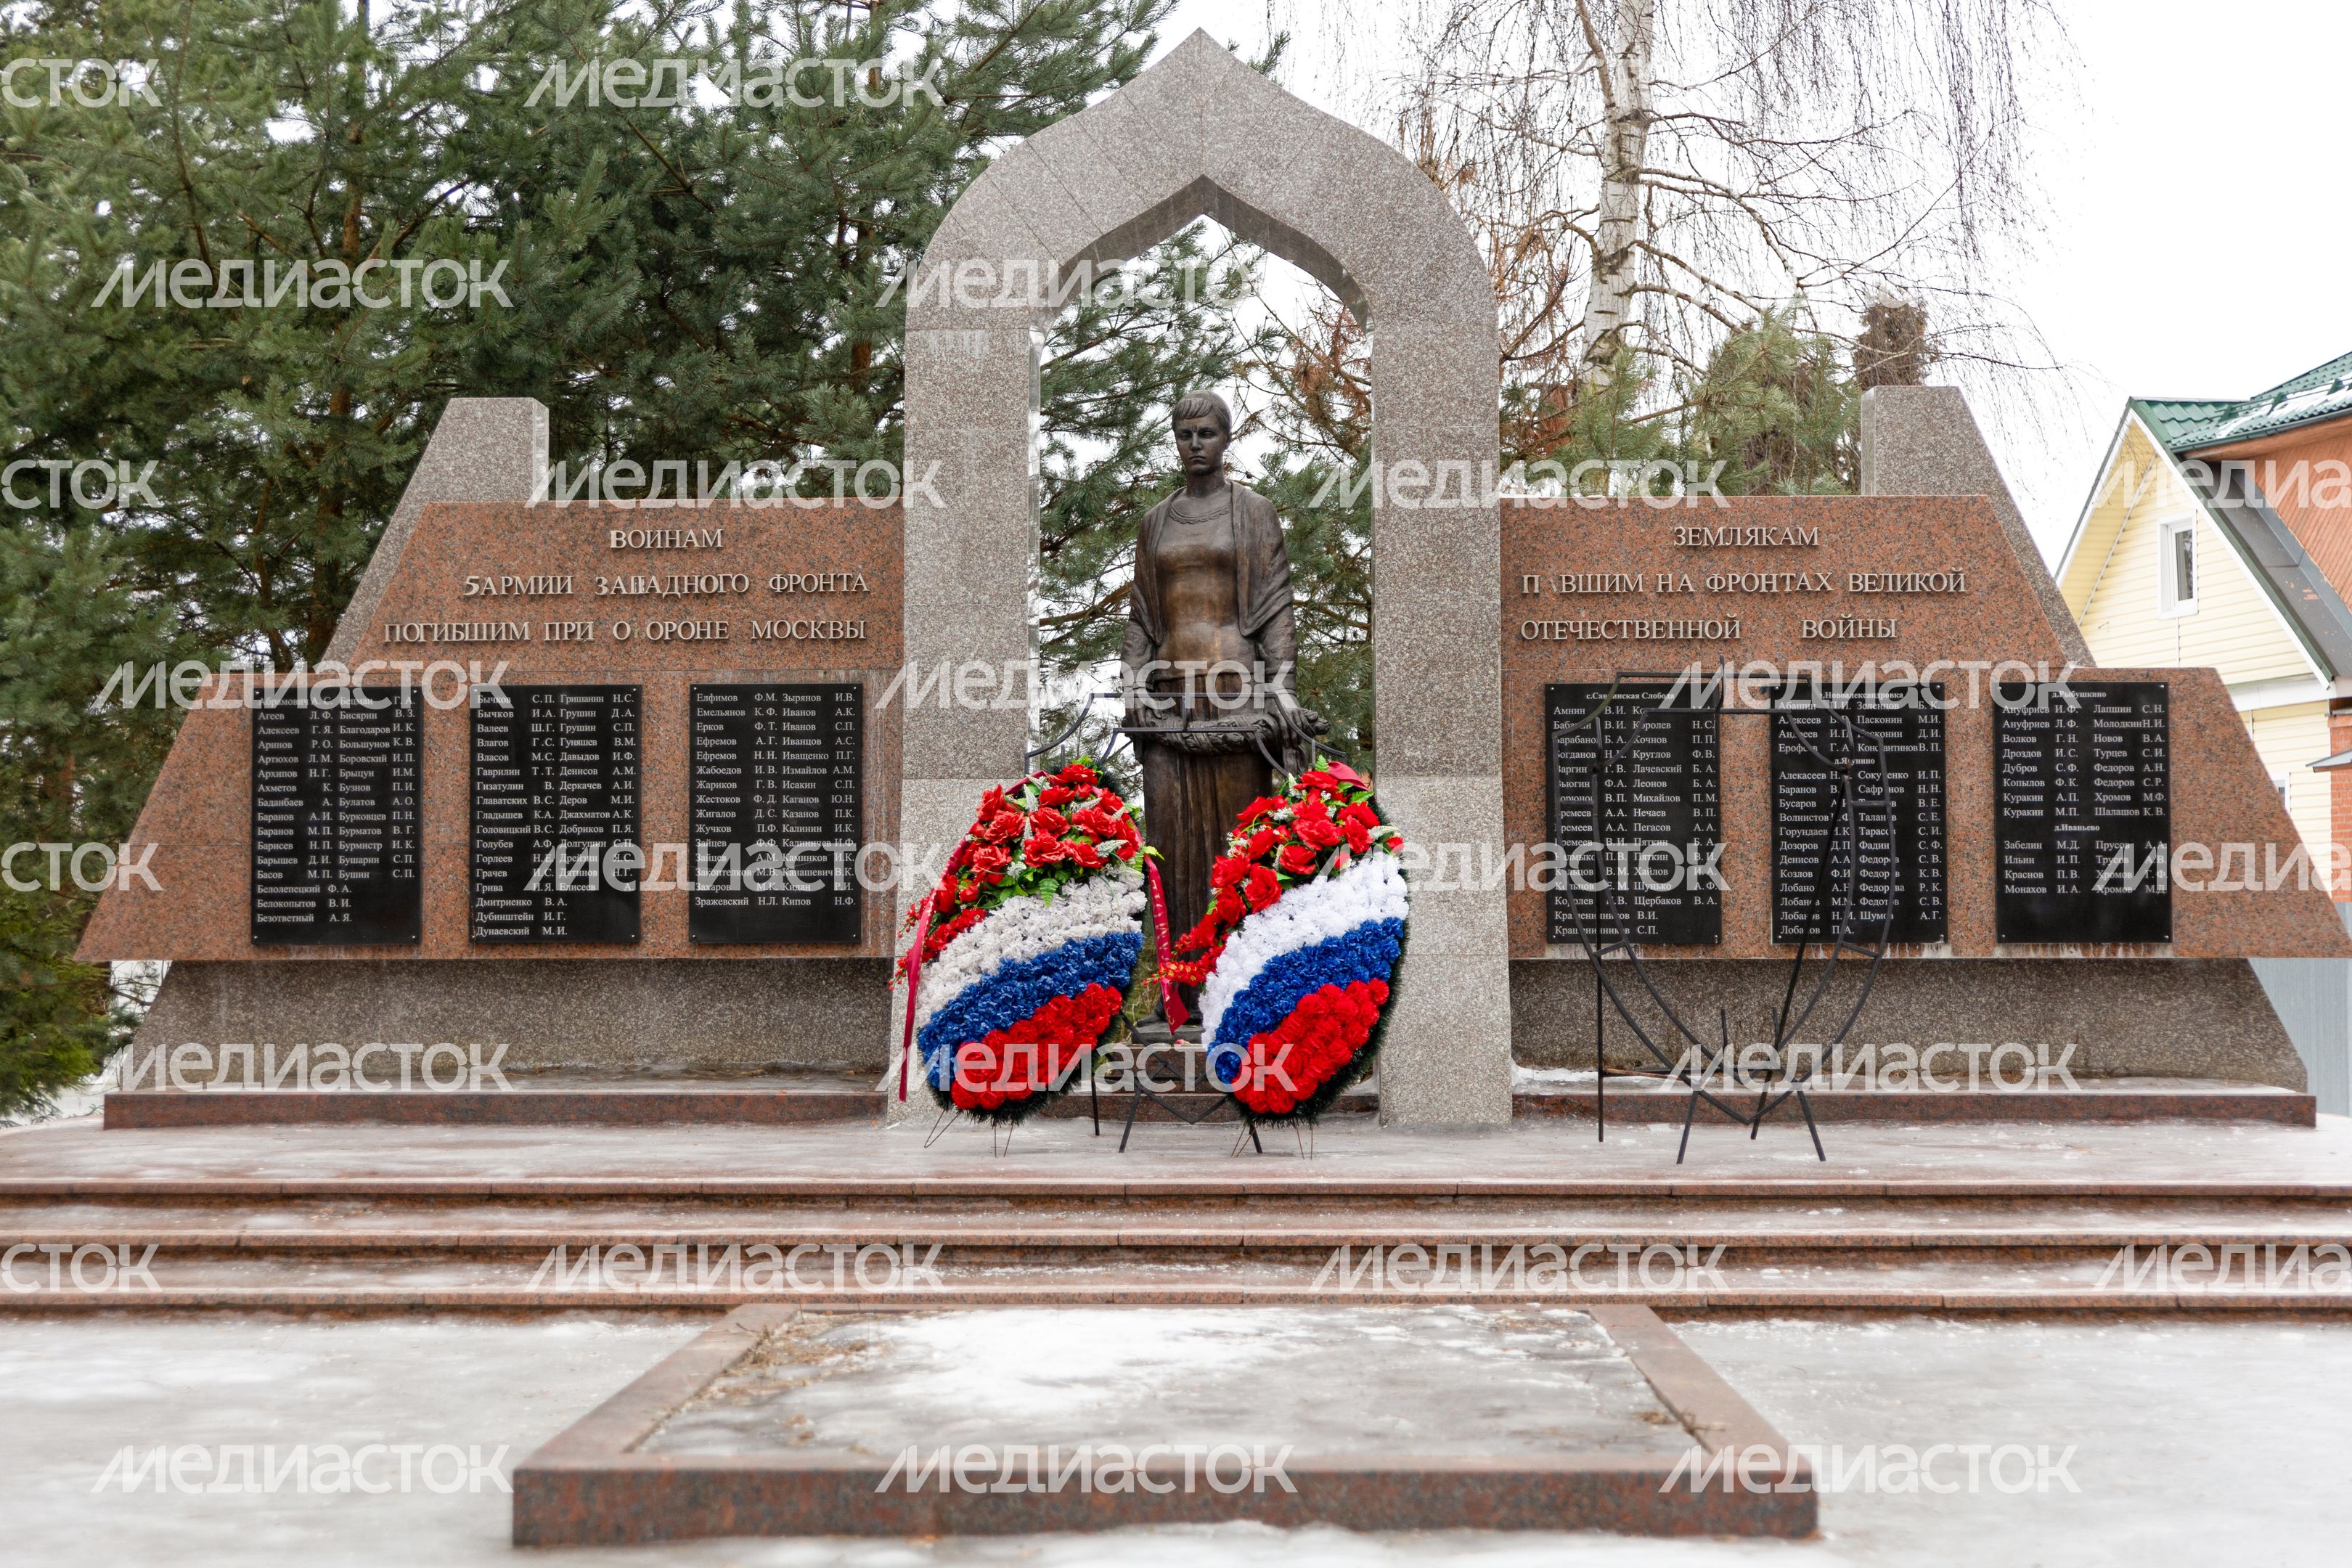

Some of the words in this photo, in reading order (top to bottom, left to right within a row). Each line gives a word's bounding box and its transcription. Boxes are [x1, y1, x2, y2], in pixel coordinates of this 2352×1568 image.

[610, 528, 724, 549] ВОИНАМ
[1673, 526, 1819, 546] ЗЕМЛЯКАМ
[1656, 573, 1696, 593] НА
[1706, 572, 1834, 593] ФРОНТАХ
[1848, 567, 1966, 593] ВЕЛИКОЙ
[595, 573, 749, 599] ЗАПАДНОГО
[768, 573, 870, 593] ФРОНТА
[383, 621, 531, 642] ПОГИБШИМ
[544, 621, 595, 642] ПРИ
[613, 621, 730, 640] ООРОНЕ
[751, 620, 867, 640] МОСКВЫ
[1521, 613, 1741, 640] ОТЕЧЕСТВЕННОЙ
[1800, 614, 1898, 639] ВОЙНЫ
[560, 694, 604, 705] Гришанин
[696, 693, 738, 704] Елфимов
[782, 693, 822, 704] Зырянов
[477, 709, 514, 718] Бычков
[560, 709, 596, 719] Грушин
[696, 707, 746, 716] Емельянов
[782, 708, 817, 716] Иванов
[1553, 706, 1585, 715] Амнин
[2093, 704, 2132, 714] Лапшин
[258, 711, 285, 720] Агеев
[340, 711, 377, 722] Бисярин
[1856, 715, 1903, 724] Пасконин
[477, 724, 509, 732] Валеев
[696, 722, 724, 733] Ерков
[2002, 719, 2051, 731] Ануфриев
[2093, 719, 2142, 729] Молодкин
[258, 726, 300, 735] Алексеев
[339, 725, 391, 736] Благодаров
[560, 737, 598, 748] Гуняшев
[696, 736, 738, 748] Ефремов
[783, 736, 822, 746] Иванцов
[2002, 734, 2037, 743] Волков
[2093, 733, 2123, 743] Новов
[339, 739, 391, 751] Большунов
[477, 752, 510, 761] Власов
[782, 751, 829, 761] Иващенко
[1633, 749, 1672, 761] Круглов
[2002, 748, 2042, 760] Дроздов
[2093, 748, 2128, 759] Турцев
[339, 754, 388, 765] Боровский
[339, 768, 375, 780] Брыцун
[476, 767, 520, 778] Гаврилин
[559, 766, 598, 777] Денисов
[696, 765, 742, 775] Жабоедов
[783, 765, 828, 775] Измайлов
[1633, 764, 1682, 773] Лачевский
[2002, 763, 2038, 775] Дубров
[2094, 763, 2135, 775] Федоров
[258, 769, 298, 780] Архипов
[1779, 771, 1827, 780] Алекасеев
[476, 781, 524, 793] Гизатулин
[559, 780, 603, 792] Деркачев
[696, 780, 738, 791] Жариков
[782, 780, 816, 789] Исакин
[1633, 778, 1667, 788] Леонов
[2003, 777, 2046, 787] Копылов
[258, 783, 297, 793] Ахметов
[1779, 785, 1817, 796] Баранов
[258, 797, 304, 807] Баданбаев
[339, 797, 376, 809] Булатов
[476, 796, 528, 805] Главатских
[696, 794, 741, 804] Жестоков
[782, 795, 820, 804] Каганов
[1633, 793, 1681, 802] Михайлов
[2003, 793, 2043, 804] Куракин
[2094, 792, 2131, 804] Хромов
[1779, 799, 1817, 810] Бусаров
[476, 810, 523, 820] Гладышев
[559, 809, 611, 820] Джахматов
[695, 809, 737, 818] Жигалов
[1633, 808, 1667, 817] Нечаев
[1779, 812, 1829, 822] Волнистов
[2094, 807, 2140, 816] Шалашов
[257, 812, 295, 823] Баранов
[339, 812, 387, 823] Бурковцев
[476, 825, 531, 835] Головицкий
[559, 824, 604, 836] Добриков
[695, 824, 732, 835] Жучков
[782, 823, 822, 833] Калинин
[1633, 822, 1671, 832] Пегасов
[1779, 827, 1829, 838] Горундаев
[2054, 823, 2100, 832] д.Иваньево
[257, 841, 294, 852] Барисев
[338, 841, 383, 852] Бурмистр
[475, 839, 514, 851] Голубев
[1779, 841, 1818, 852] Дозоров
[2004, 840, 2043, 849] Забелин
[257, 855, 298, 867] Барышев
[338, 855, 380, 866] Бушарин
[1779, 854, 1819, 866] Денисов
[2004, 855, 2035, 865] Ильин
[475, 868, 508, 880] Грачев
[1780, 869, 1813, 878] Козлов
[2004, 870, 2044, 881] Краснов
[257, 884, 321, 894] Белолепецкий
[2004, 884, 2047, 894] Монахов
[257, 899, 317, 908] Белокопытов
[475, 897, 533, 909] Дмитриенко
[695, 897, 749, 908] Зражевский
[782, 897, 812, 906] Кипов
[1634, 896, 1682, 907] Щербаков
[257, 913, 314, 923] Безответный
[475, 912, 534, 923] Дубинштейн
[475, 926, 530, 938] Дунаевский
